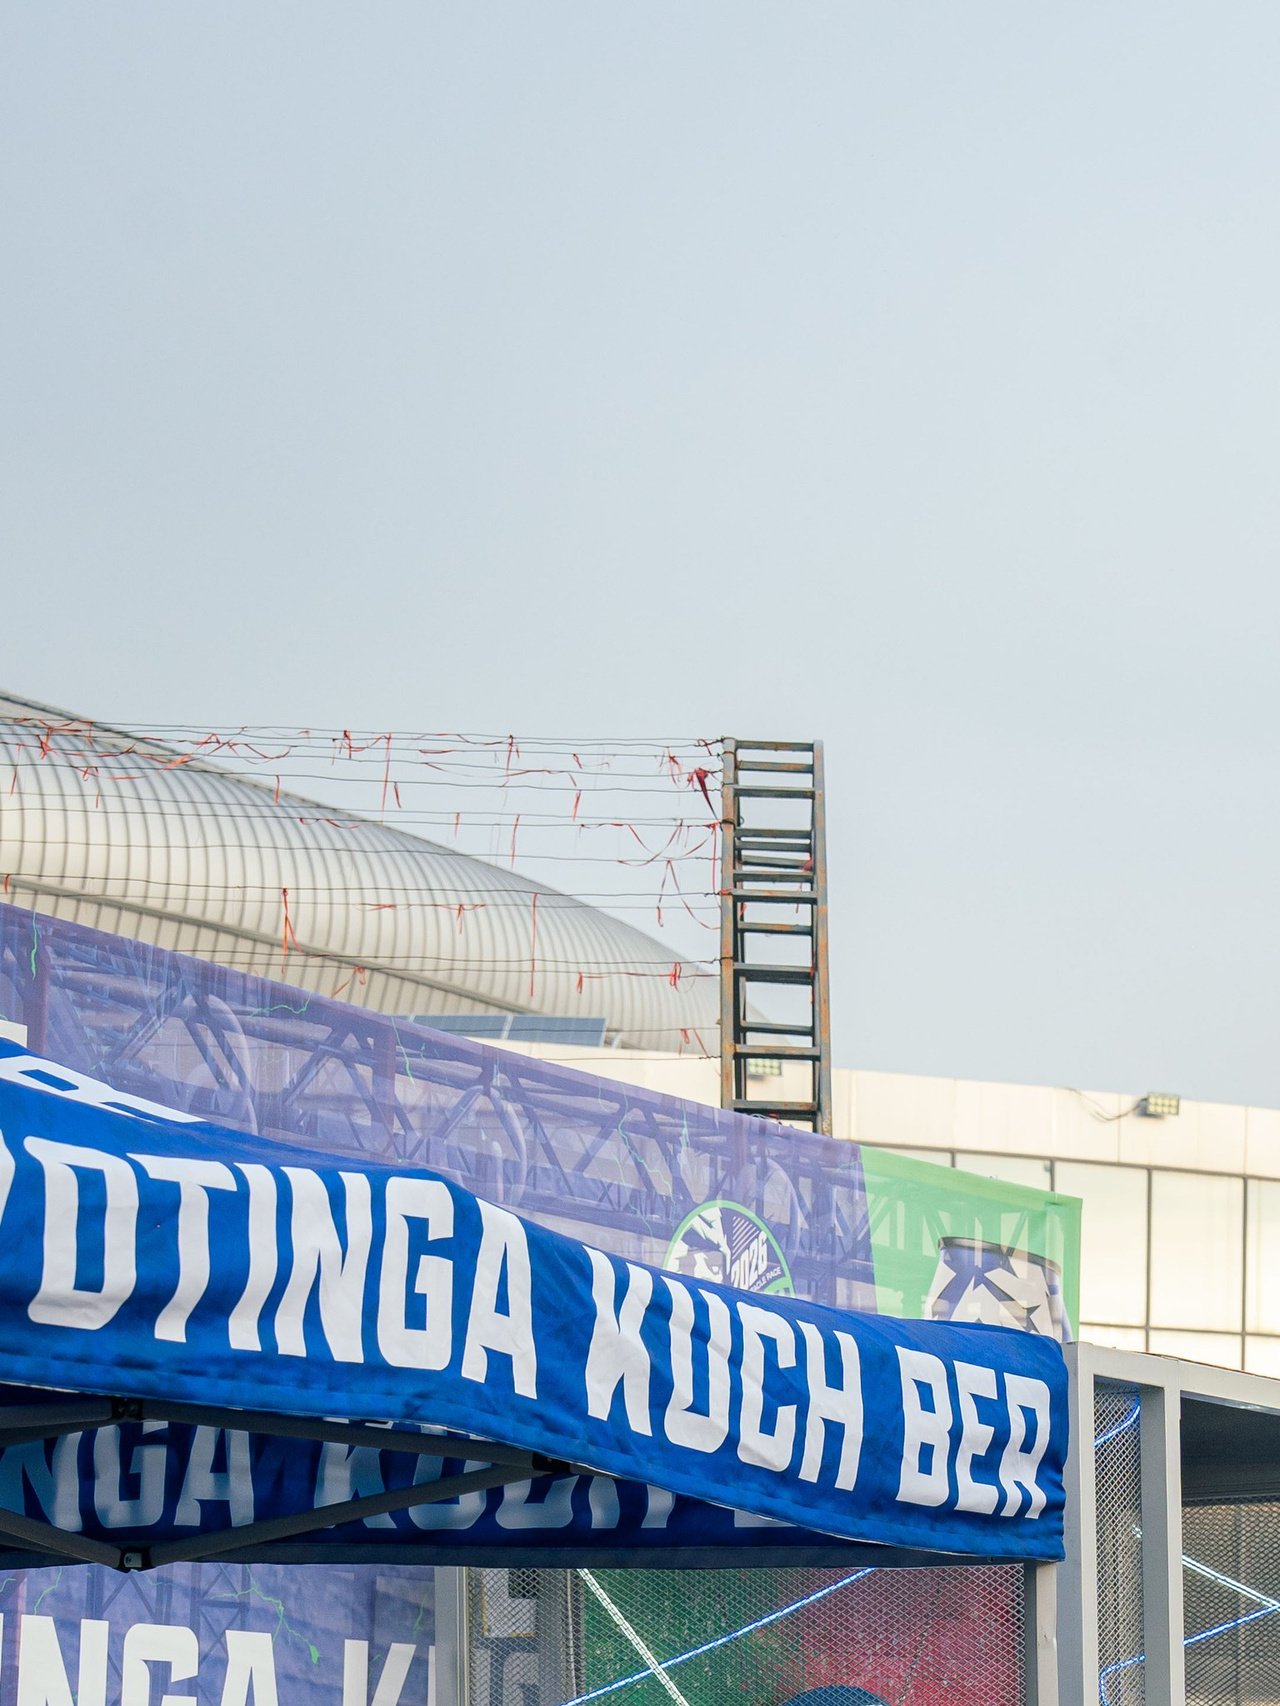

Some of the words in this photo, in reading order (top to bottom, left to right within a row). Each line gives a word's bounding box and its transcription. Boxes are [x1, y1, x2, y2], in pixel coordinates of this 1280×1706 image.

[0, 1128, 538, 1400] OTINGA
[582, 1245, 864, 1491] KUCH
[895, 1345, 1050, 1521] BER
[766, 1266, 782, 1281] RACE
